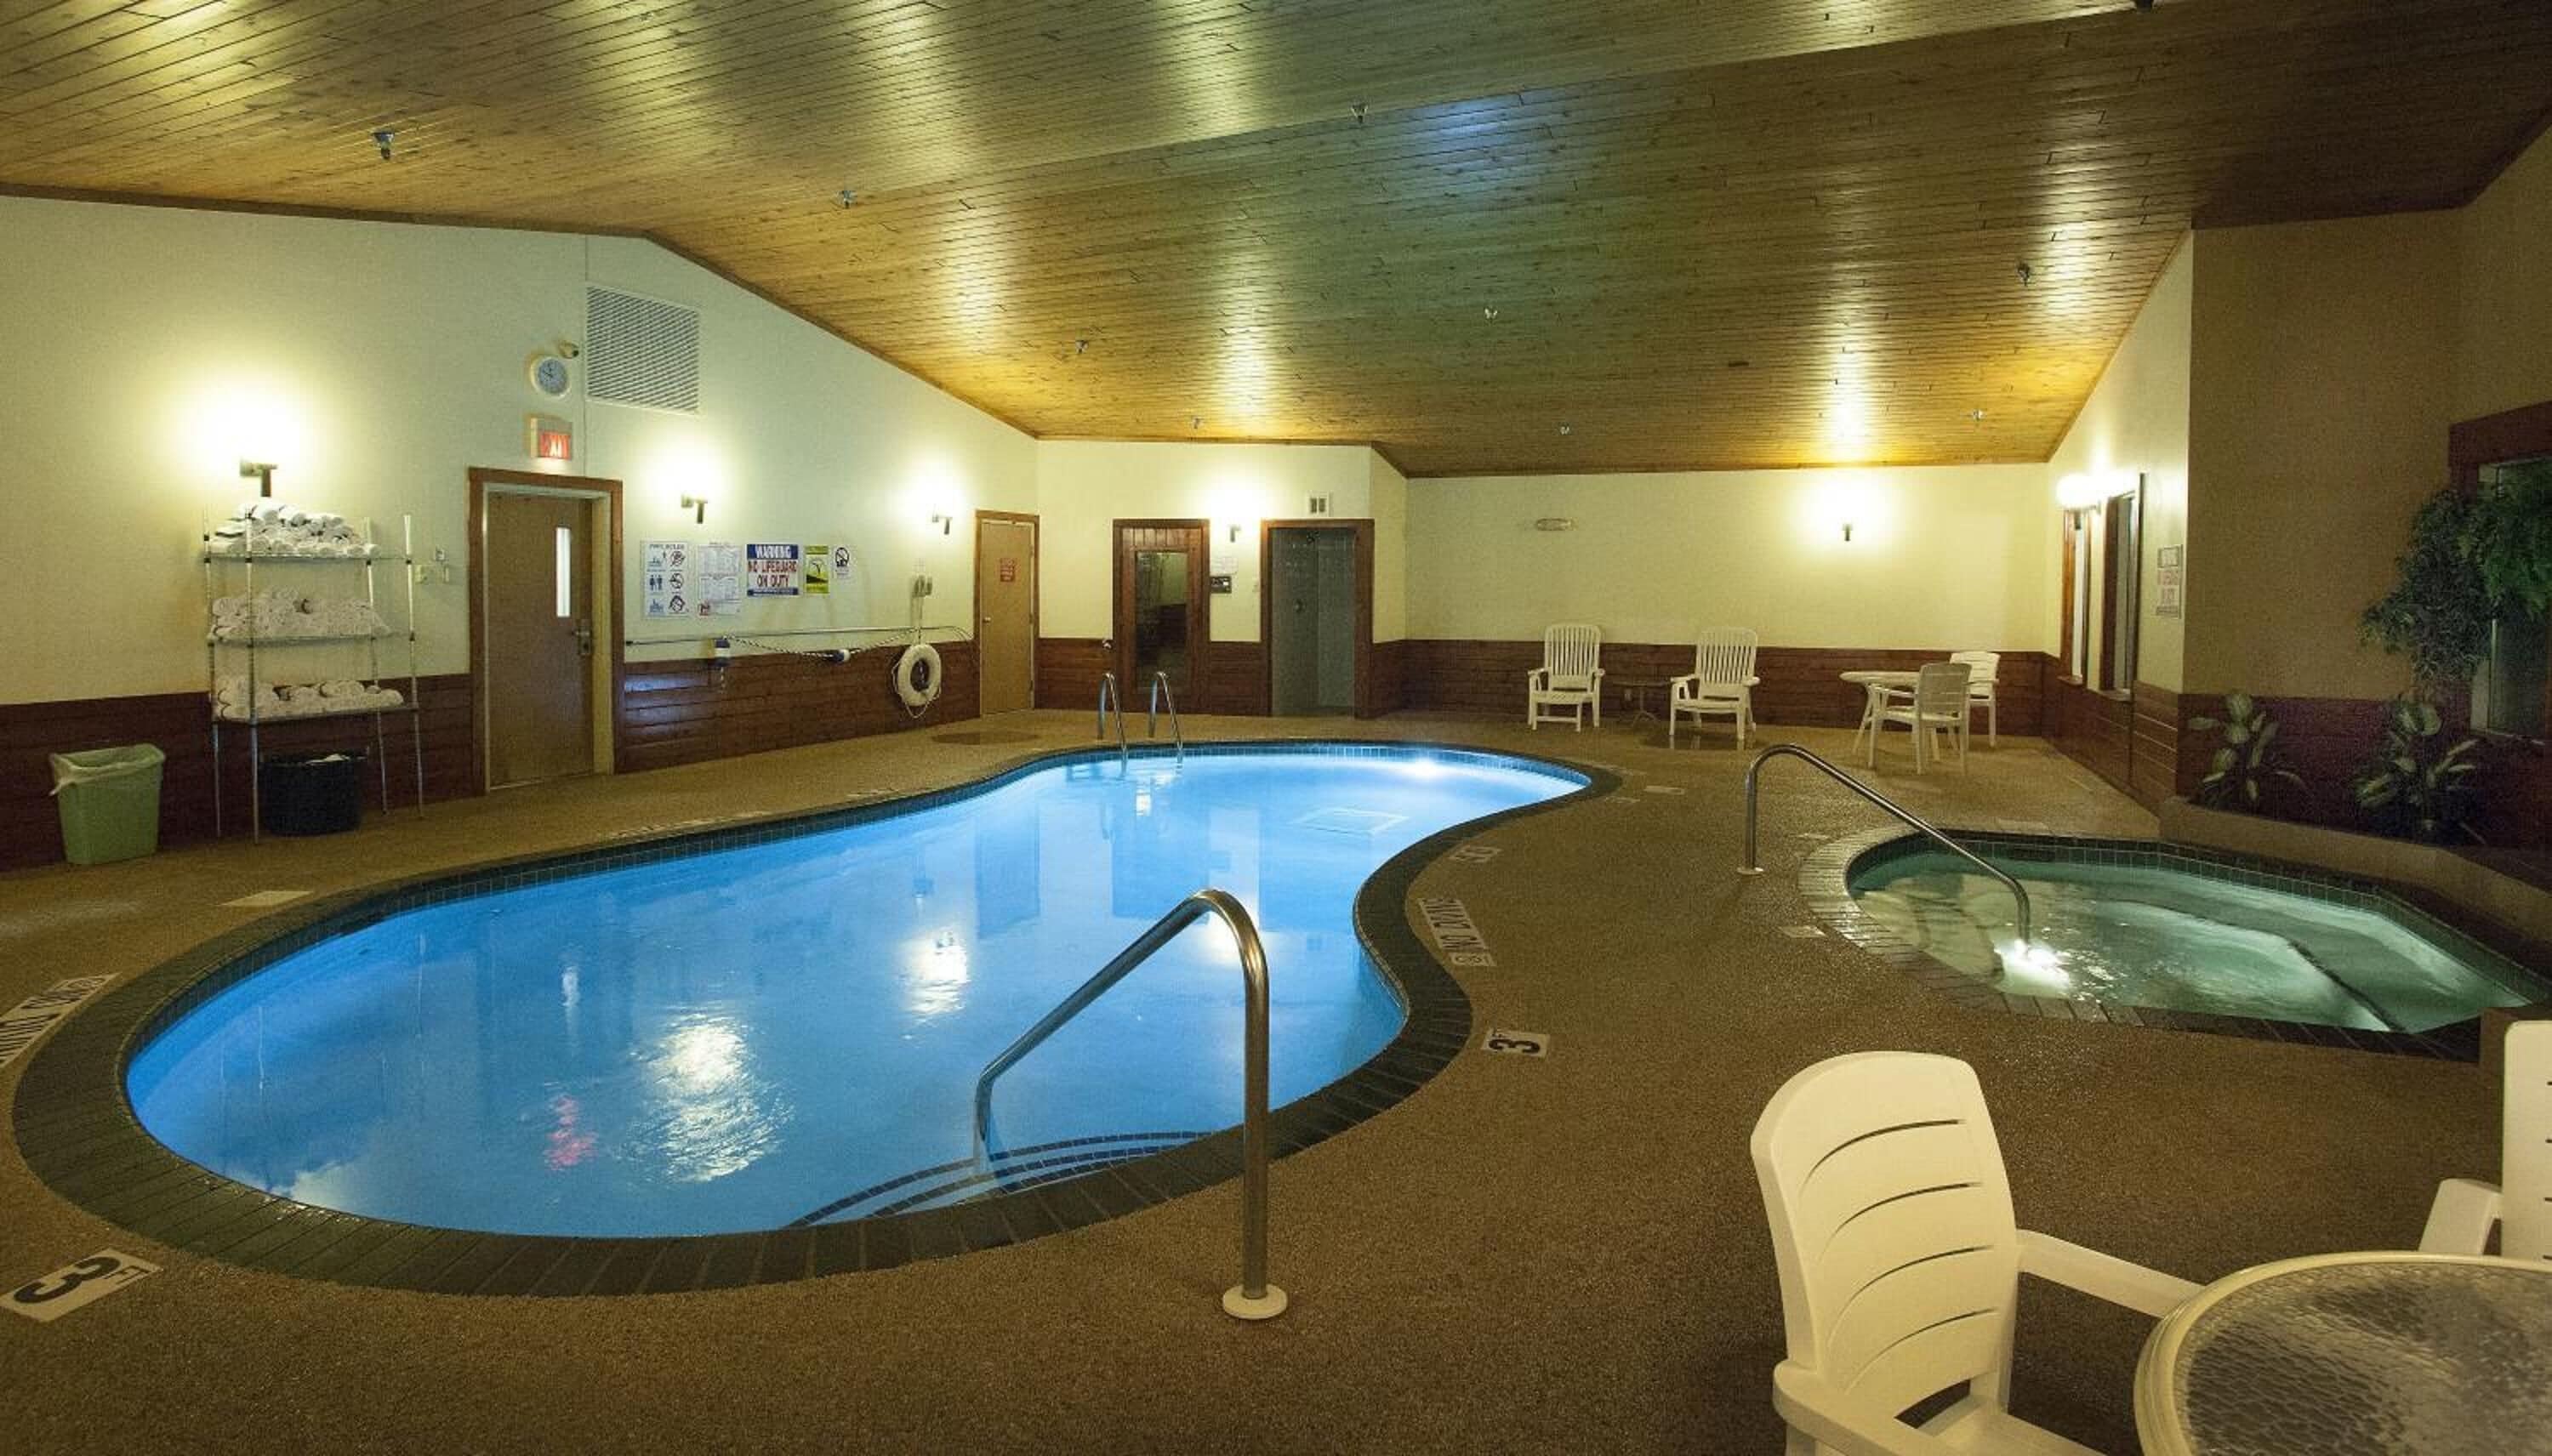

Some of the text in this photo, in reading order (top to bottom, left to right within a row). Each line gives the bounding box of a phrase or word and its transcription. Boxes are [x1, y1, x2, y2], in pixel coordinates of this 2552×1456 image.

[755, 545, 792, 559] WARNING
[749, 561, 797, 572] NO LIFEGUARD
[756, 574, 789, 588] ON DUTY
[1489, 1039, 1540, 1054] 3
[14, 1257, 122, 1303] 3
